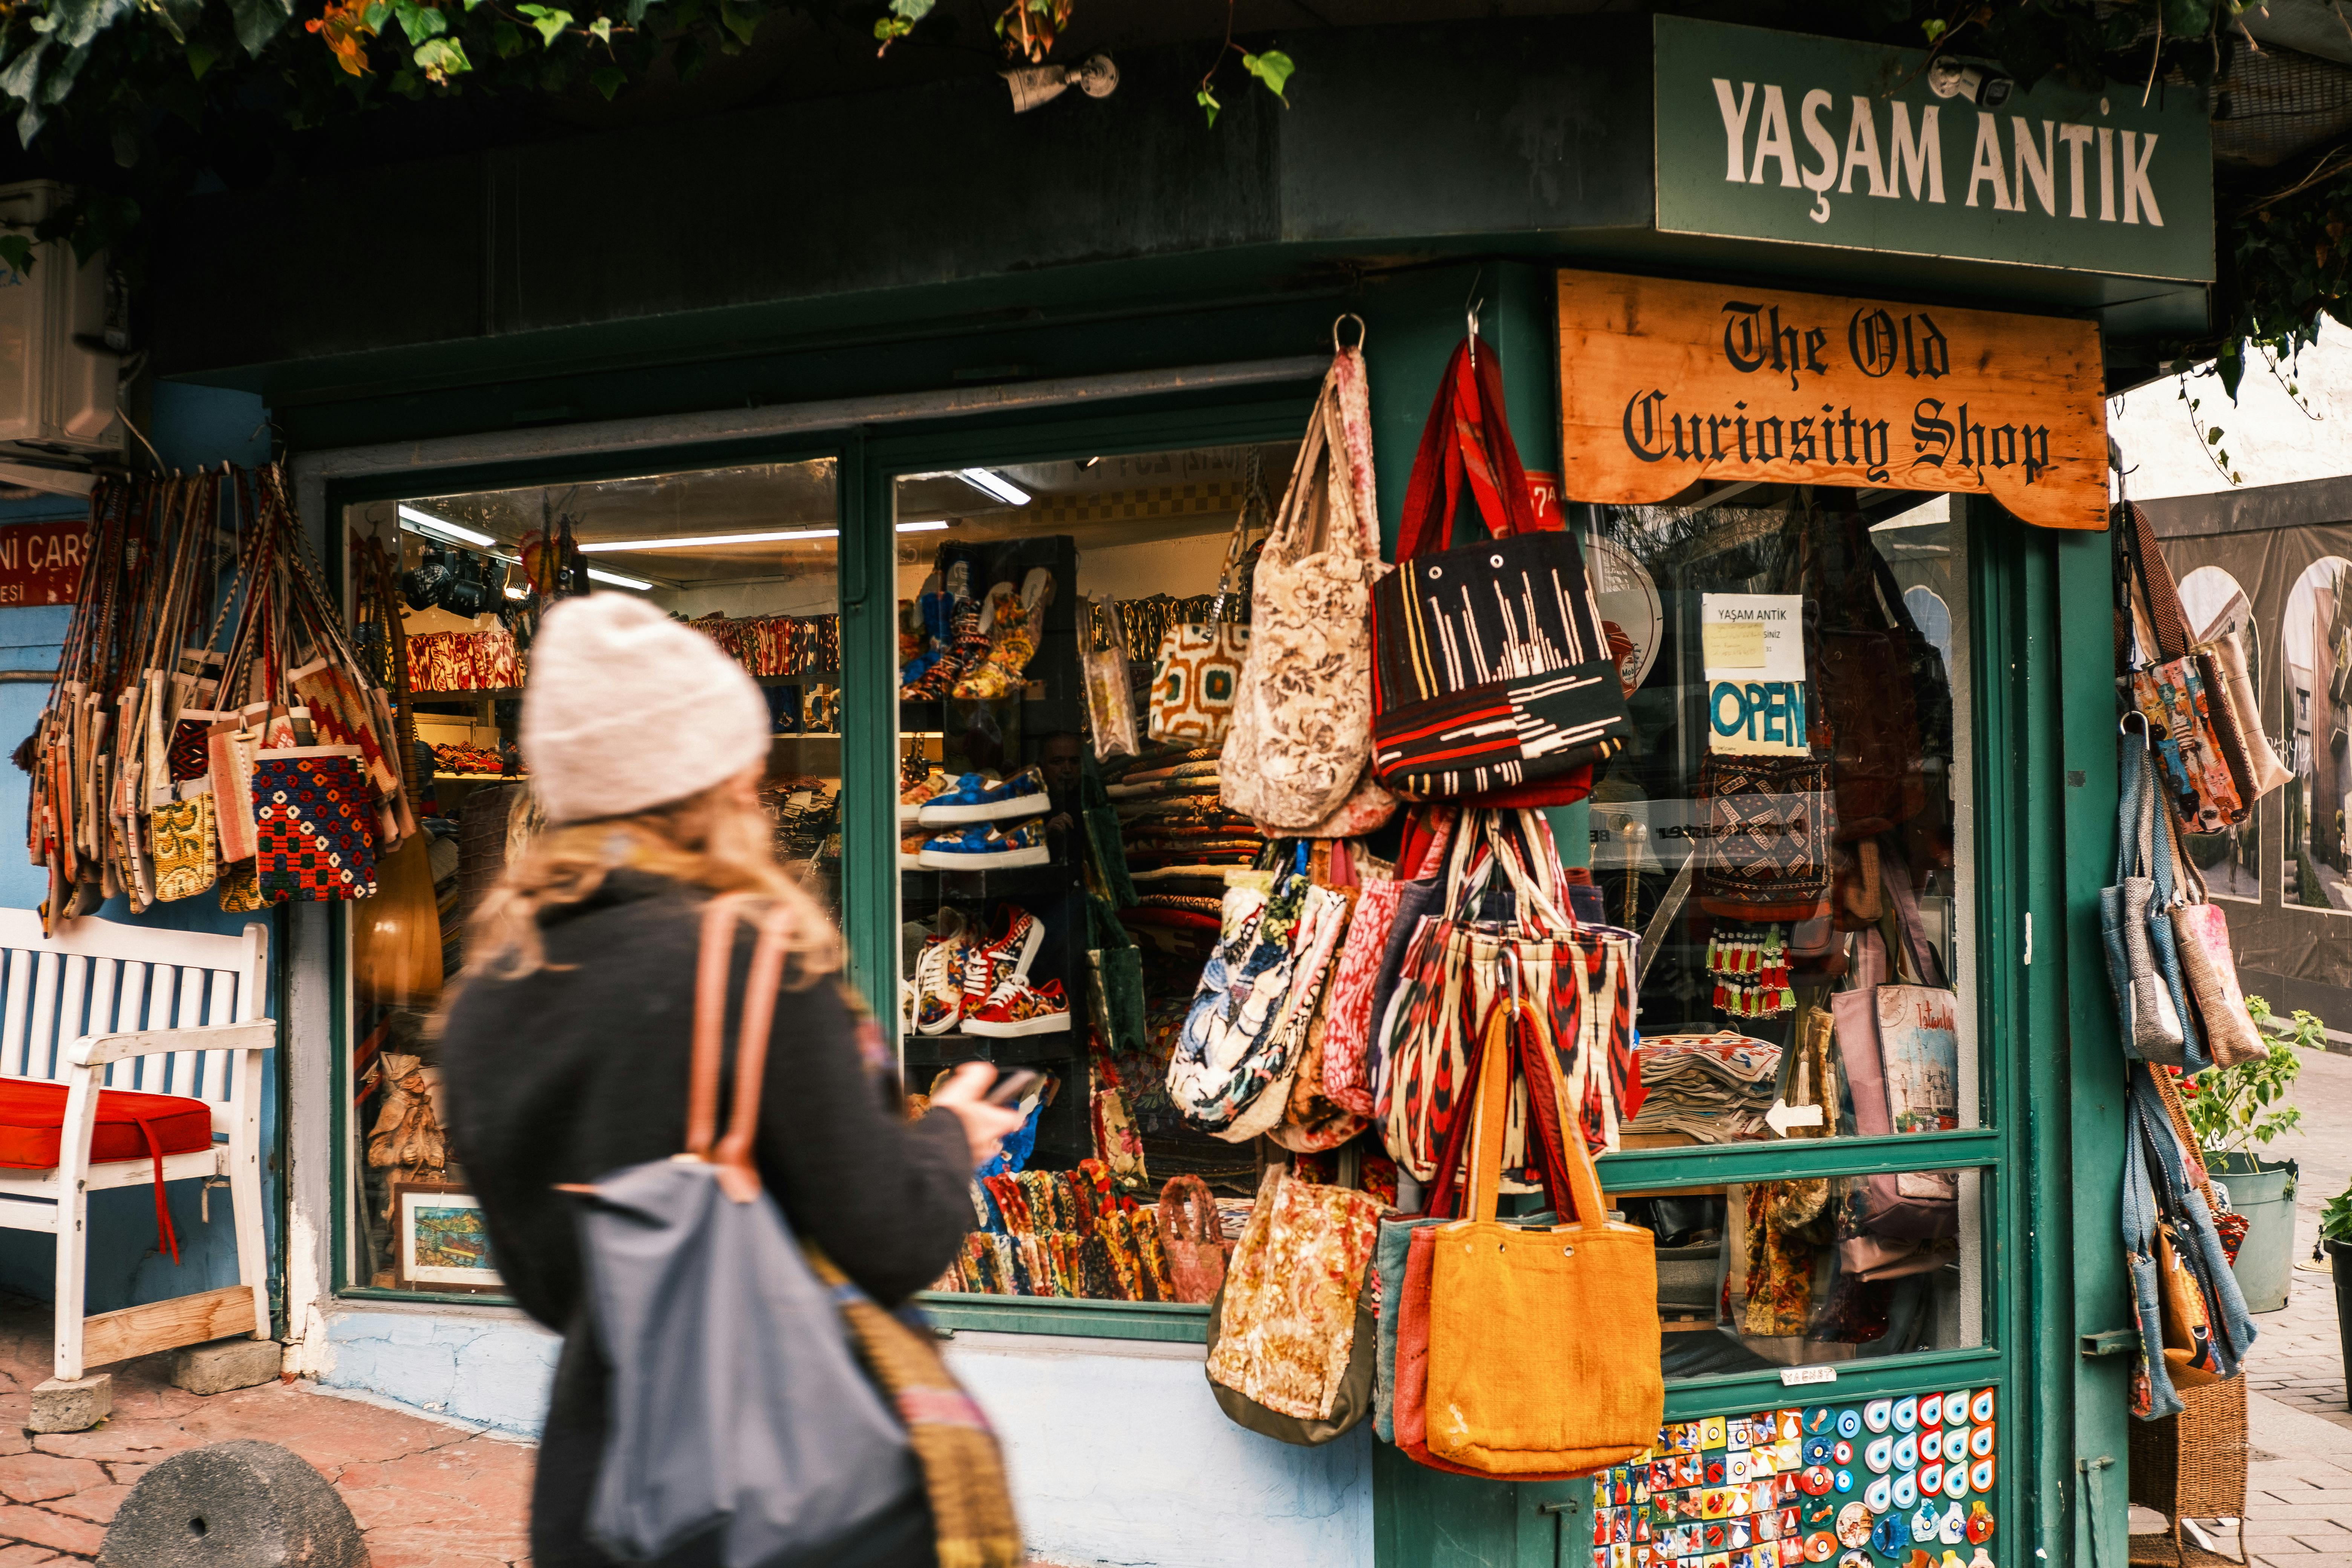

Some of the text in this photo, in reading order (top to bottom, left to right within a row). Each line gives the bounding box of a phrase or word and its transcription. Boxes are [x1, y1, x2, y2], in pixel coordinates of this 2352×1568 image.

[1712, 77, 2164, 227] YAŞAM ANTİK
[1721, 300, 1951, 392] The Old
[1623, 389, 2050, 486] Curiosity Shop
[1718, 608, 1787, 622] YAŞAM ANTİK
[1710, 681, 1807, 747] OPEN
